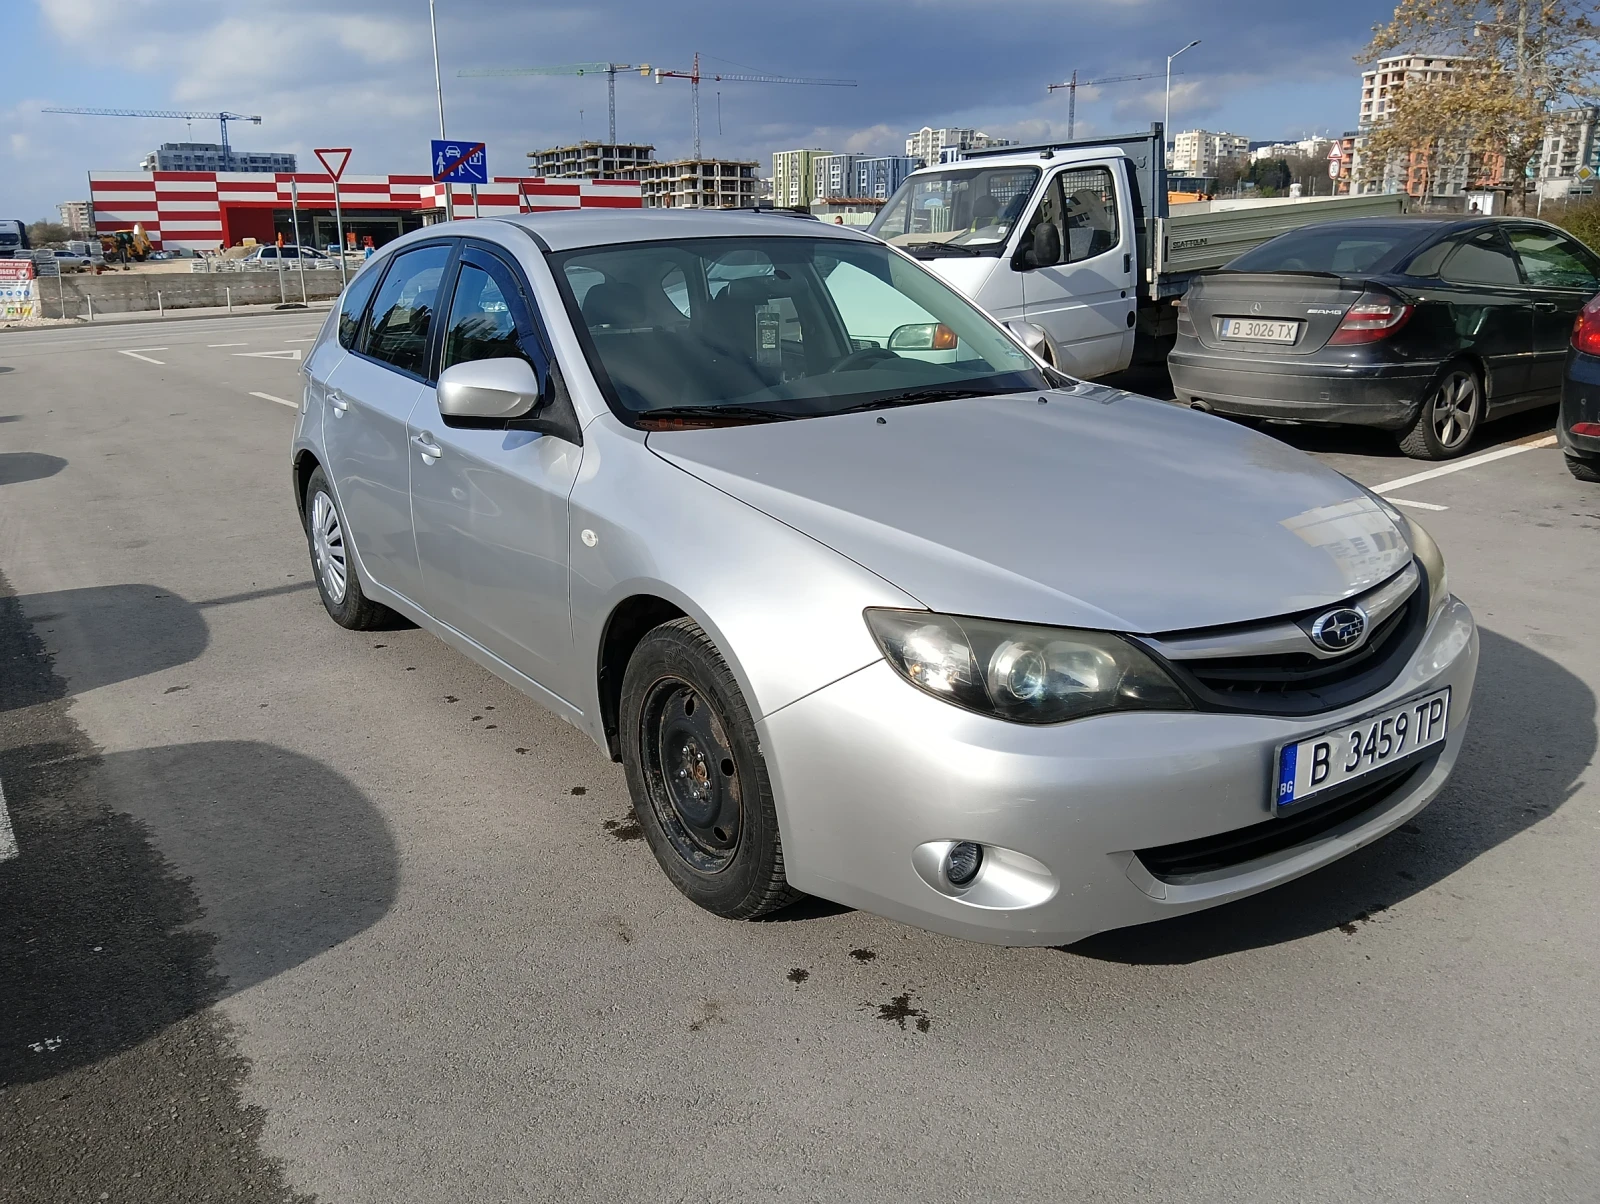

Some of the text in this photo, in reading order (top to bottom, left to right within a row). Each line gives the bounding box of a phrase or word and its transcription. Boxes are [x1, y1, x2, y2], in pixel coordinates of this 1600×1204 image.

[1232, 322, 1241, 336] B
[1245, 322, 1275, 337] 3026
[1278, 324, 1294, 339] TX
[1308, 698, 1443, 787] B 3459 TP
[1279, 780, 1293, 796] BG
